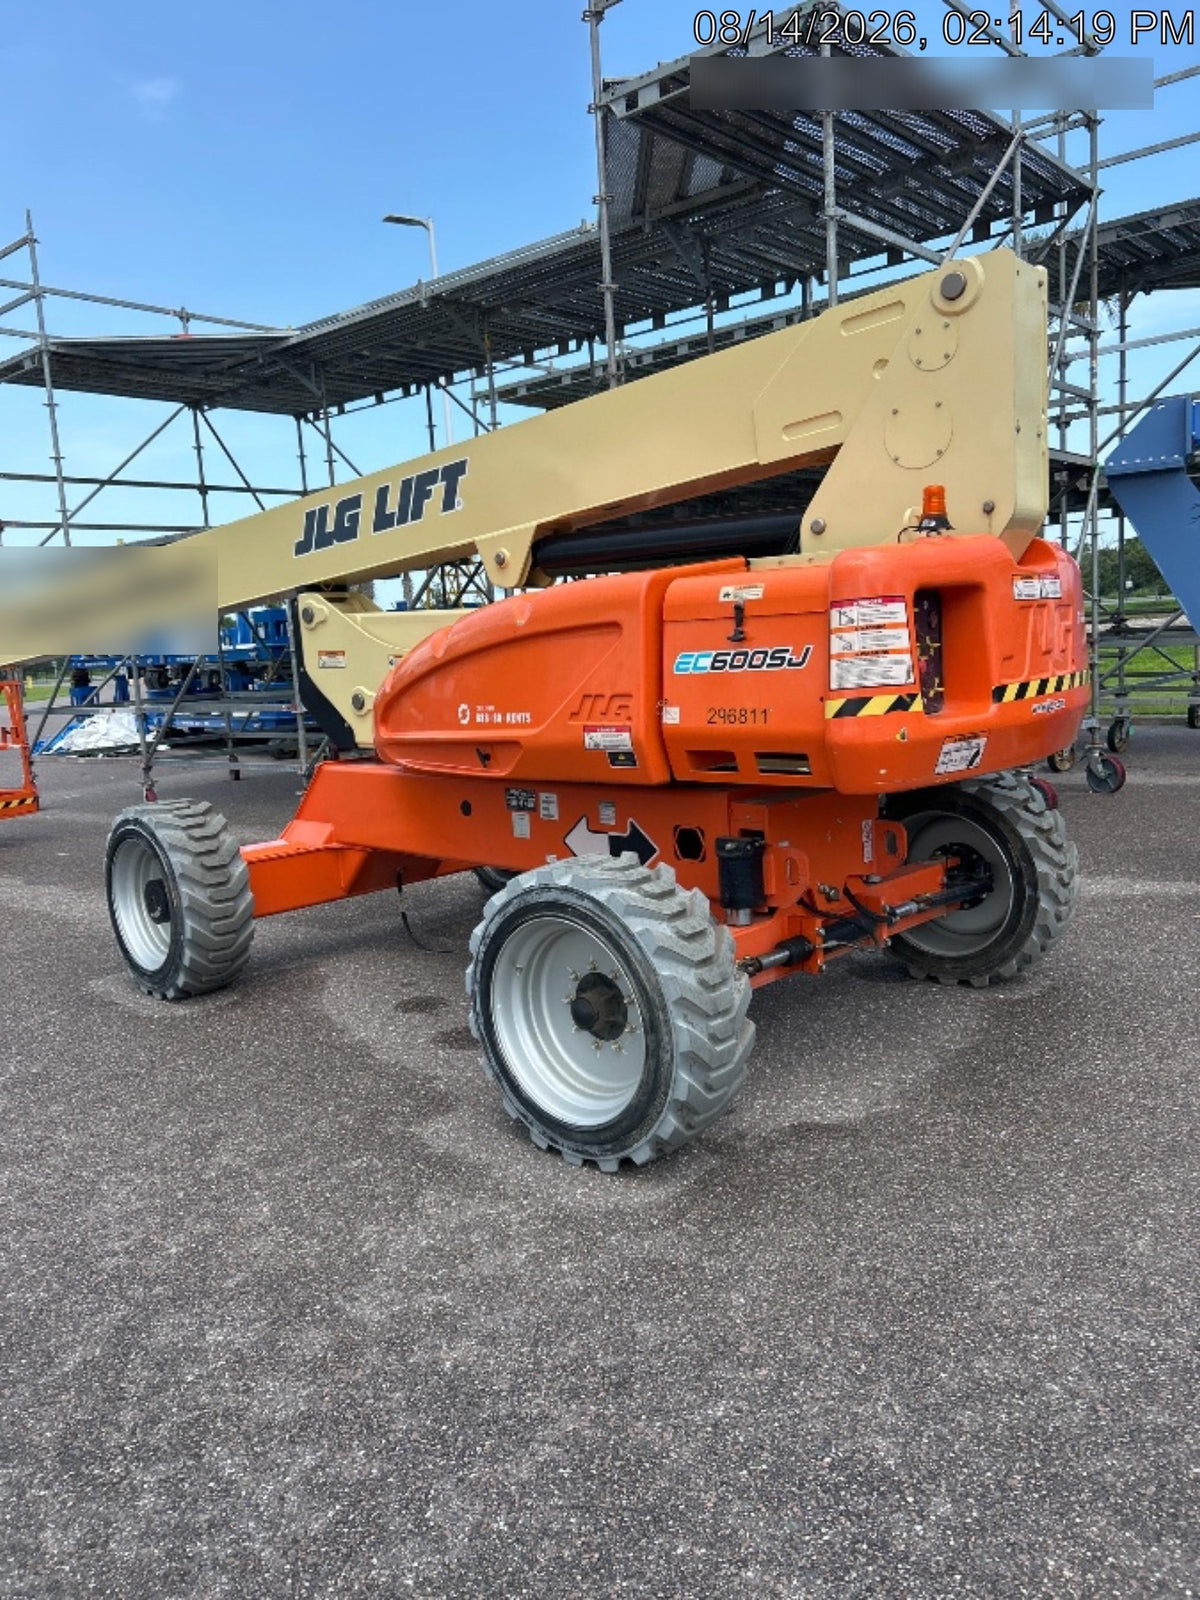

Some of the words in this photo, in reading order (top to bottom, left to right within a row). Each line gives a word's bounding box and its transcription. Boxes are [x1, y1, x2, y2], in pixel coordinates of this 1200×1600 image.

[294, 494, 363, 557] JLG
[372, 458, 469, 534] LIFT
[674, 645, 813, 675] EC600SJ
[707, 707, 768, 725] 296811
